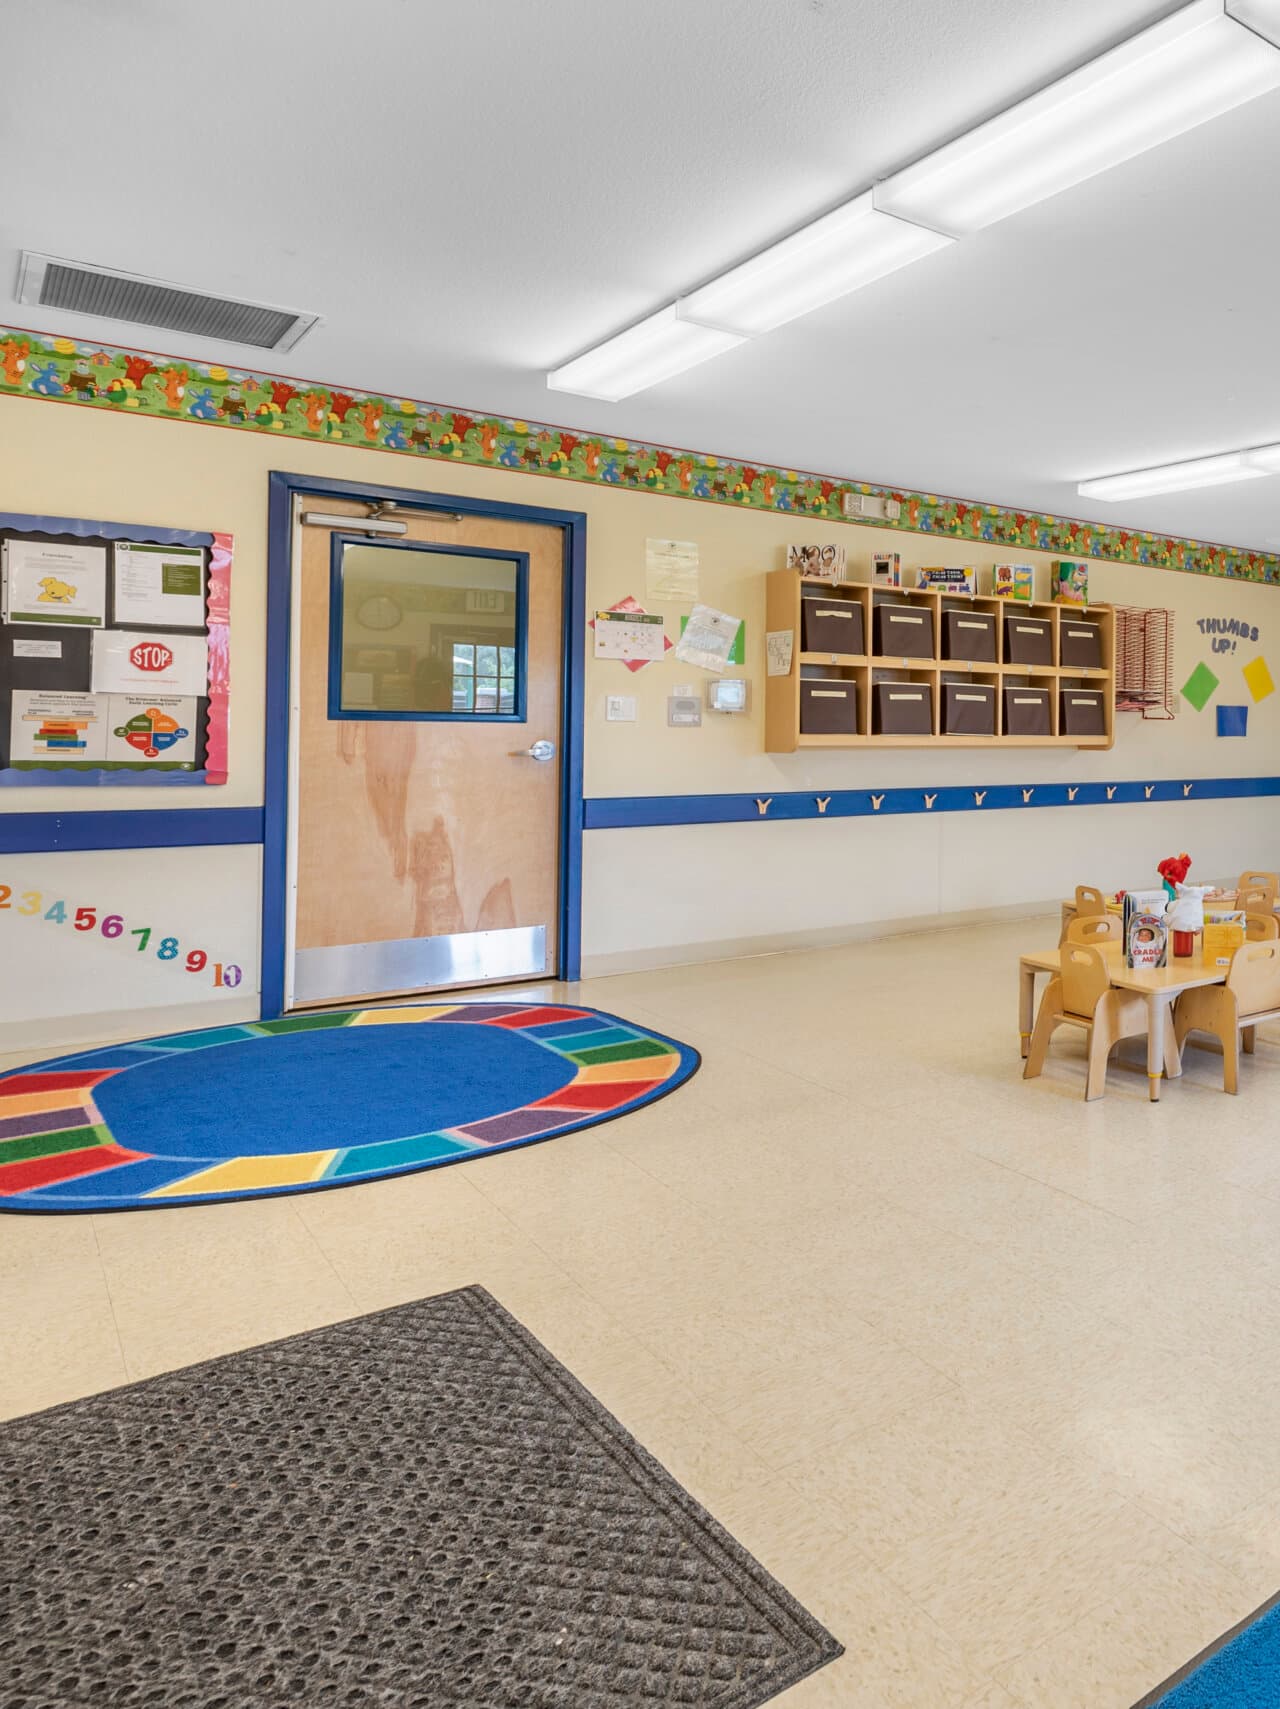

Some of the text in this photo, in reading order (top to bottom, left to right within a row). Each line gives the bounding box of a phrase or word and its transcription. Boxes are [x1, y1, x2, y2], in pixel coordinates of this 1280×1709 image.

[792, 545, 836, 563] MOO
[1196, 618, 1259, 642] THUMBS
[1212, 637, 1237, 655] UP!
[133, 646, 170, 668] STOP
[17, 890, 43, 916] 3
[44, 900, 67, 924] 4
[74, 907, 97, 931] 5
[101, 914, 124, 938] 6
[131, 927, 152, 951] 7
[157, 937, 179, 960] 8
[185, 949, 208, 973] 9
[212, 963, 242, 988] 10
[1133, 948, 1163, 956] CRADLE
